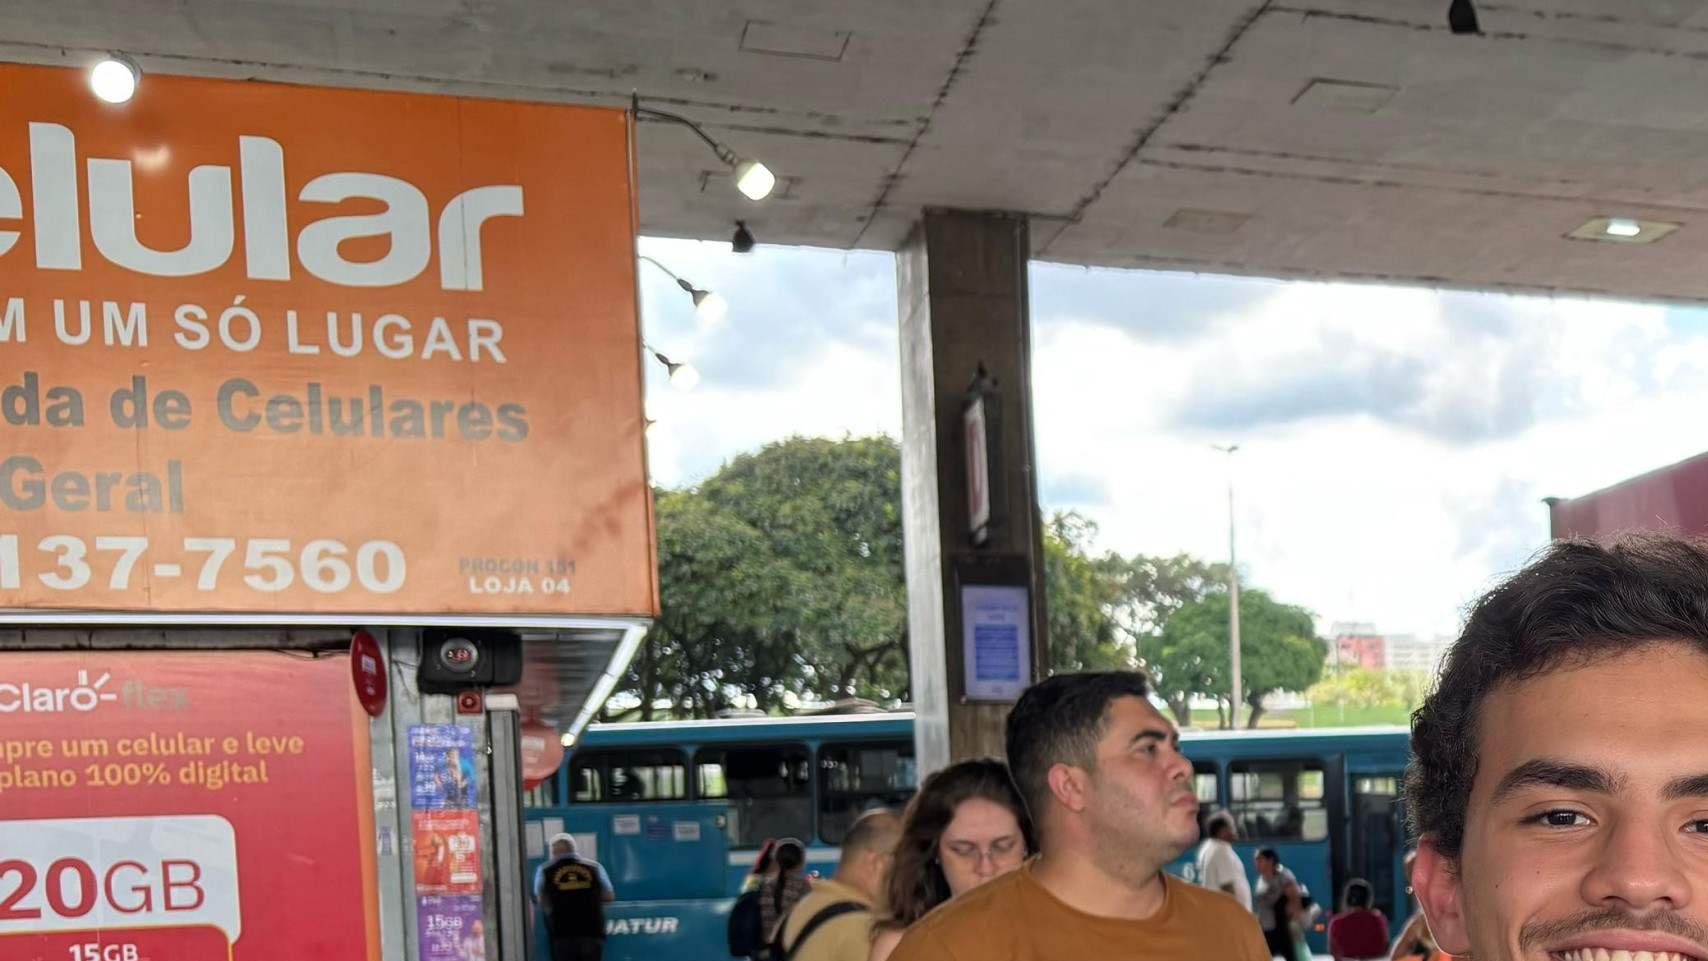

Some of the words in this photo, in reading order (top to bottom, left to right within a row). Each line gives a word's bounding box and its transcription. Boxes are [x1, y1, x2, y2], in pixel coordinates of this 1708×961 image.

[0, 121, 524, 291] lular
[53, 299, 148, 347] UM
[173, 294, 261, 352] SÓ
[287, 310, 506, 363] LUGAR
[2, 371, 84, 427] da
[110, 374, 192, 430] de
[216, 378, 530, 443] Celulares
[0, 455, 183, 513] Geral
[0, 534, 406, 593] 137-7560
[468, 576, 534, 594] LOJA
[542, 577, 571, 594] 04
[0, 674, 106, 712] Claro
[0, 739, 53, 764] pre
[62, 739, 107, 757] um
[117, 731, 215, 756] celular
[222, 736, 239, 754] e
[246, 731, 304, 755] leve
[0, 764, 77, 793] plano
[85, 762, 171, 788] 100%
[179, 759, 269, 790] digital
[0, 856, 206, 920] 20GB
